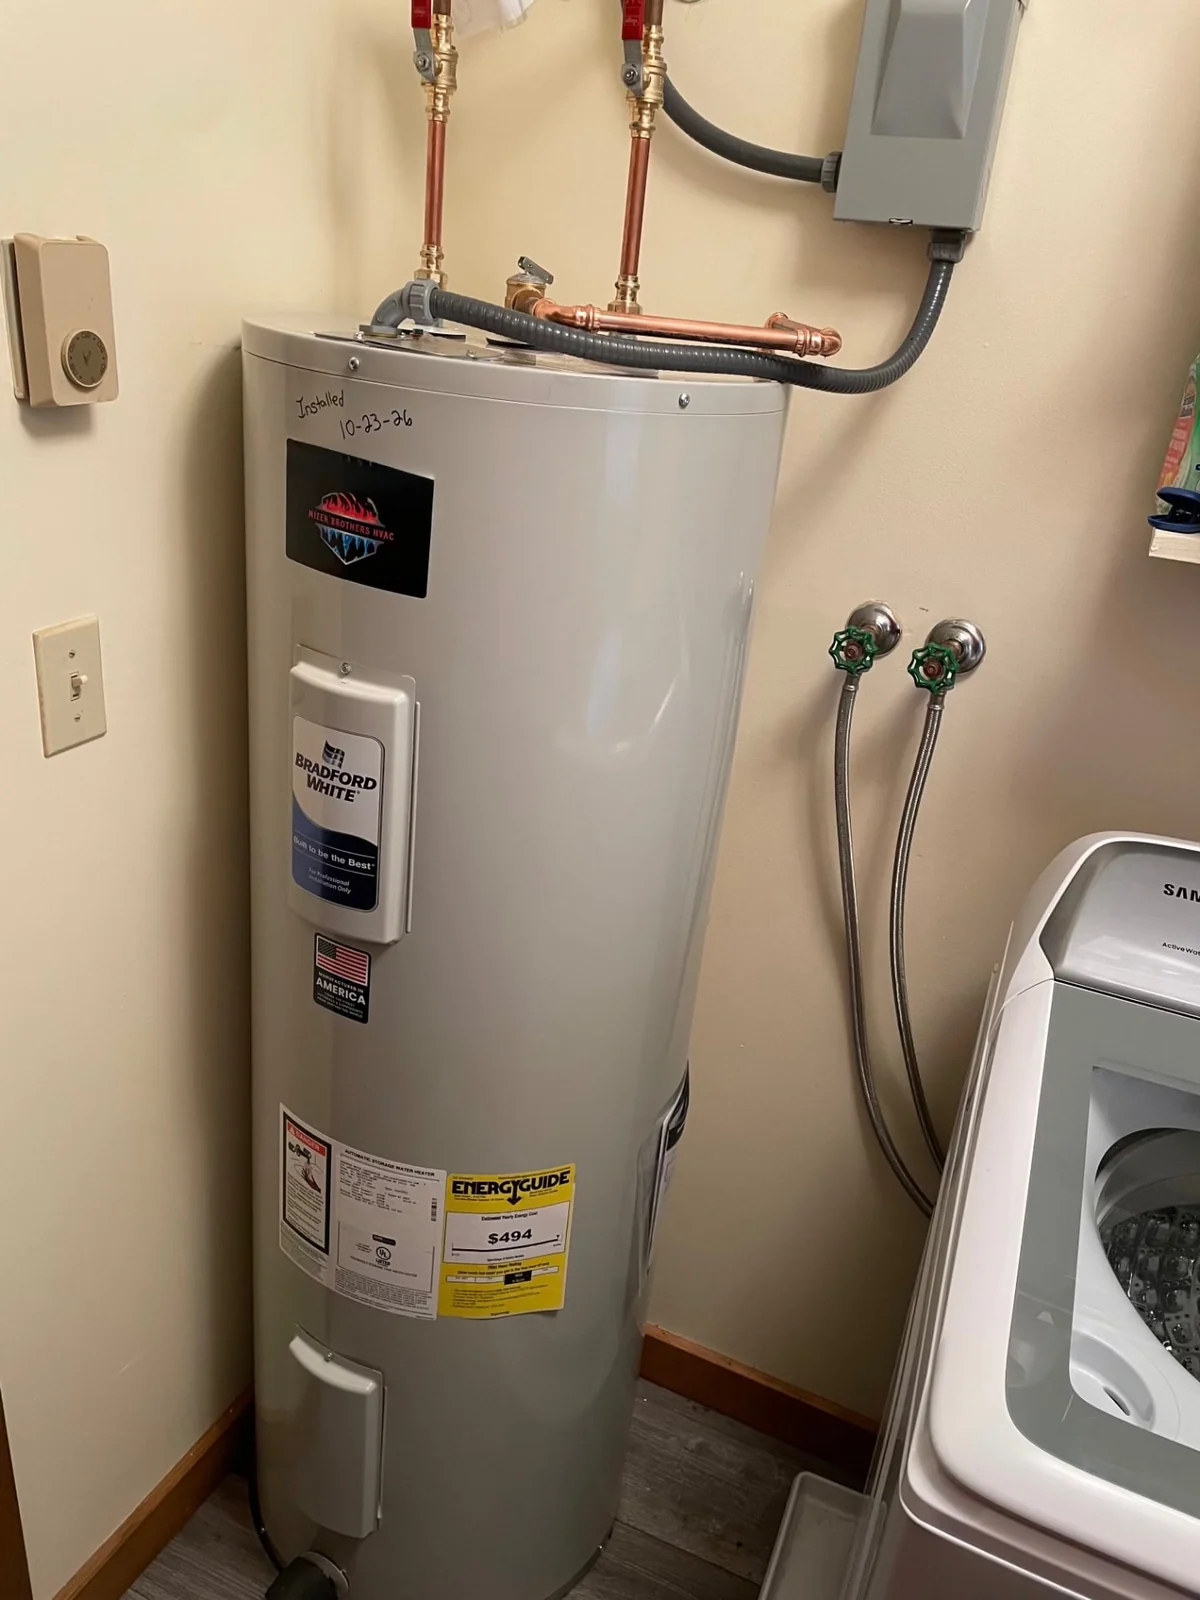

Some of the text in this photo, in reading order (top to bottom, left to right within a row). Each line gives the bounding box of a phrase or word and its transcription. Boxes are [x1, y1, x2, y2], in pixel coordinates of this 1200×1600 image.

[296, 389, 344, 419] Installed
[339, 409, 413, 440] 10-23-26
[330, 517, 370, 535] BROTHERS
[373, 529, 395, 541] HVAC
[295, 752, 377, 790] BRADFORD
[306, 773, 356, 803] WHITE
[293, 835, 371, 870] Built to be the Best
[337, 885, 352, 895] Only
[316, 977, 366, 1006] AMERICA
[345, 1149, 435, 1177] AUTOMATIC STORAGE WATER HEATER
[487, 1228, 532, 1245] $494
